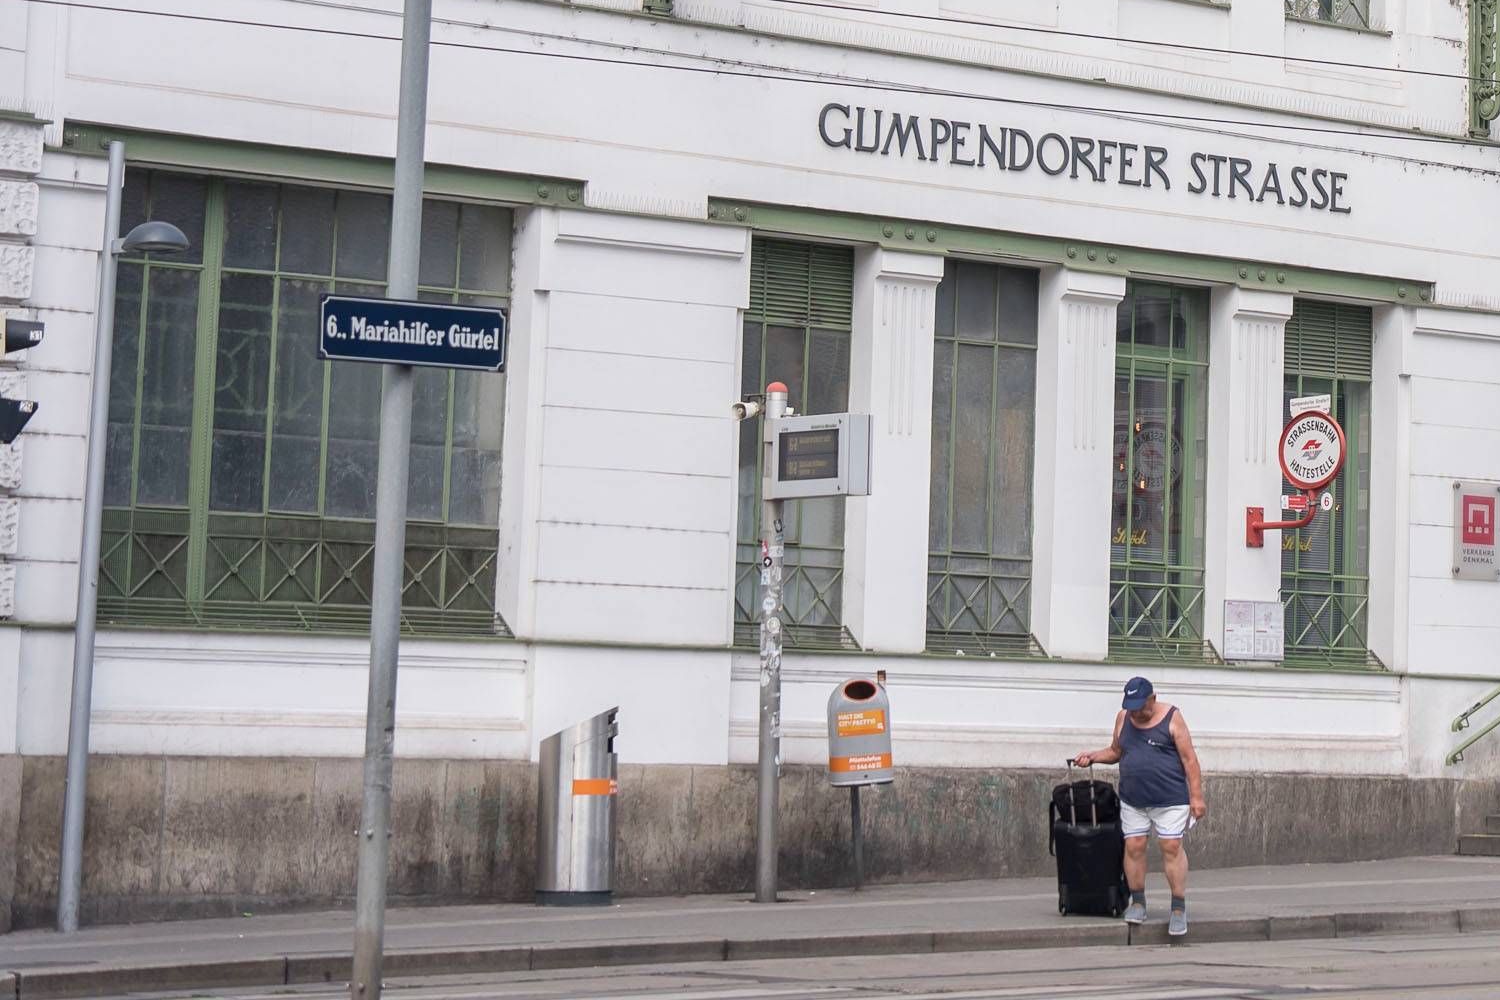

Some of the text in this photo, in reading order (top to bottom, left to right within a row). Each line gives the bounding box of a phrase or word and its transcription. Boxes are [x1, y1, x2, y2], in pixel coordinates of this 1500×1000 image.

[818, 102, 1352, 214] GUMPENDORFER STRASSE
[351, 316, 445, 346] Mariahilfer
[449, 324, 499, 351] Gürtel
[1287, 420, 1337, 447] STRASSENBAHN
[1290, 456, 1335, 479] HALTESTELLE
[1324, 496, 1330, 507] 6
[1462, 548, 1495, 557] VERKEHRS
[1463, 556, 1493, 564] DENKMAL
